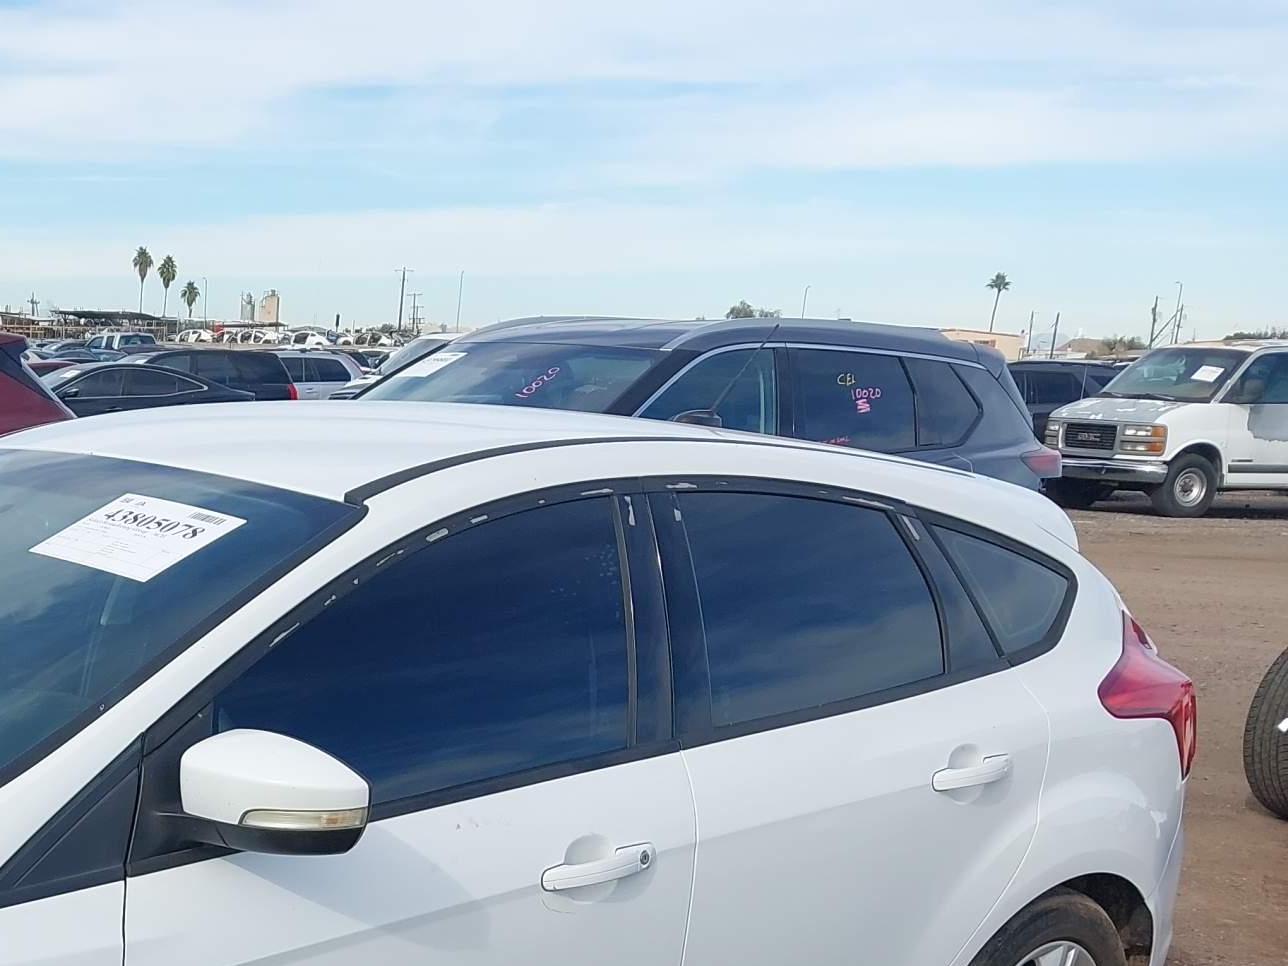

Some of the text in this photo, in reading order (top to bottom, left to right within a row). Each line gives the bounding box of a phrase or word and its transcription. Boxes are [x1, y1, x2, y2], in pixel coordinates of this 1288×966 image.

[515, 366, 560, 398] 10020
[851, 388, 881, 400] 10020
[104, 508, 205, 539] 43805078
